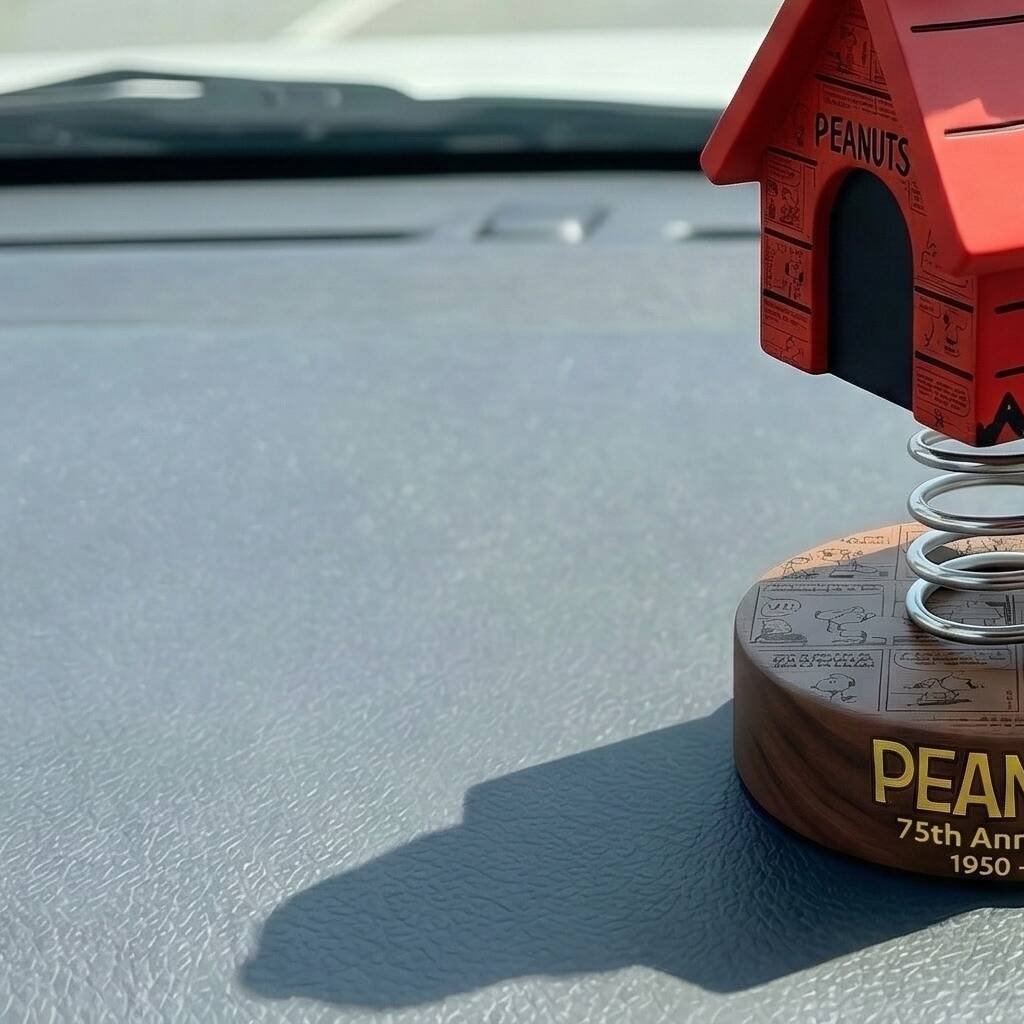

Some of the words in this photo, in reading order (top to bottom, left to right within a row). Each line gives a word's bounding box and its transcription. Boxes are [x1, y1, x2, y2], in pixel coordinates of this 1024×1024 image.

[815, 112, 911, 177] PEANUTS
[897, 818, 962, 846] 75th
[950, 853, 1011, 877] 1950
